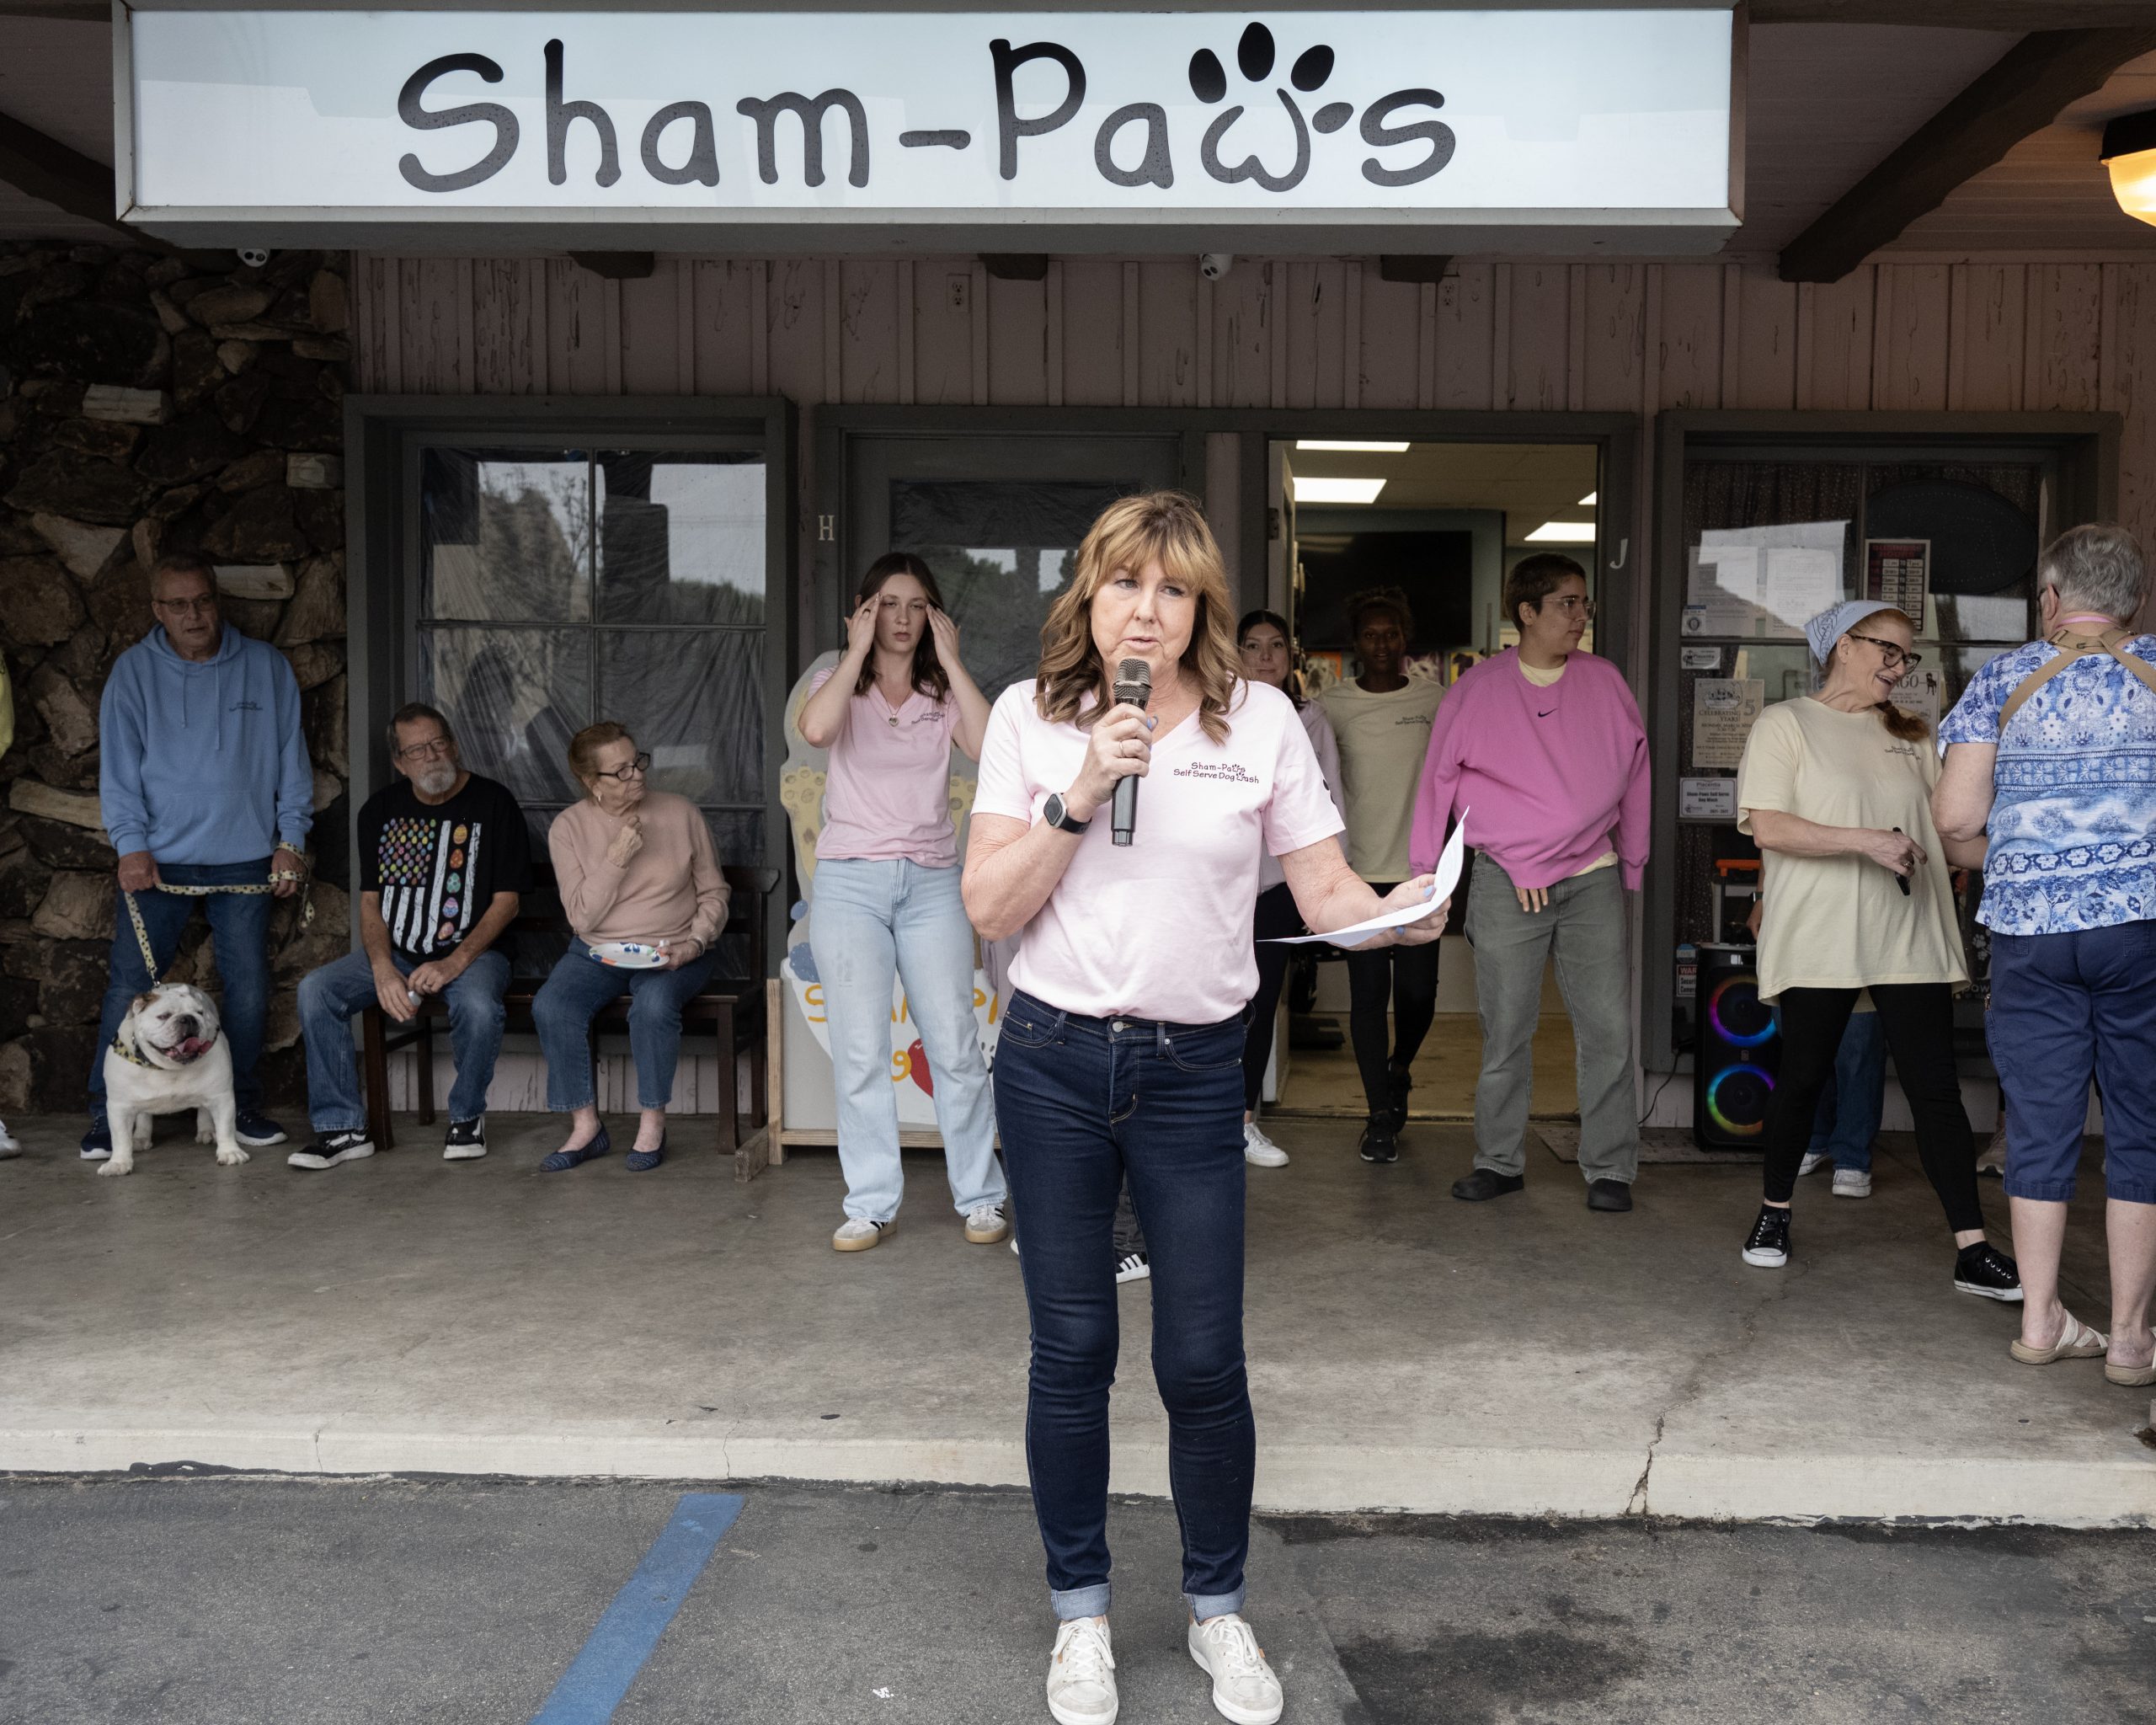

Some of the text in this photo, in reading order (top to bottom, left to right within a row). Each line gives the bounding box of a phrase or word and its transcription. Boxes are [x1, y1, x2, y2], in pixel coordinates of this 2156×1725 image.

[398, 34, 1457, 193] Sham-Paws
[818, 515, 835, 541] H
[1609, 537, 1629, 569] J
[1173, 768, 1260, 784] Self Serve Dog Wash
[1191, 761, 1246, 773] Sham-Paws
